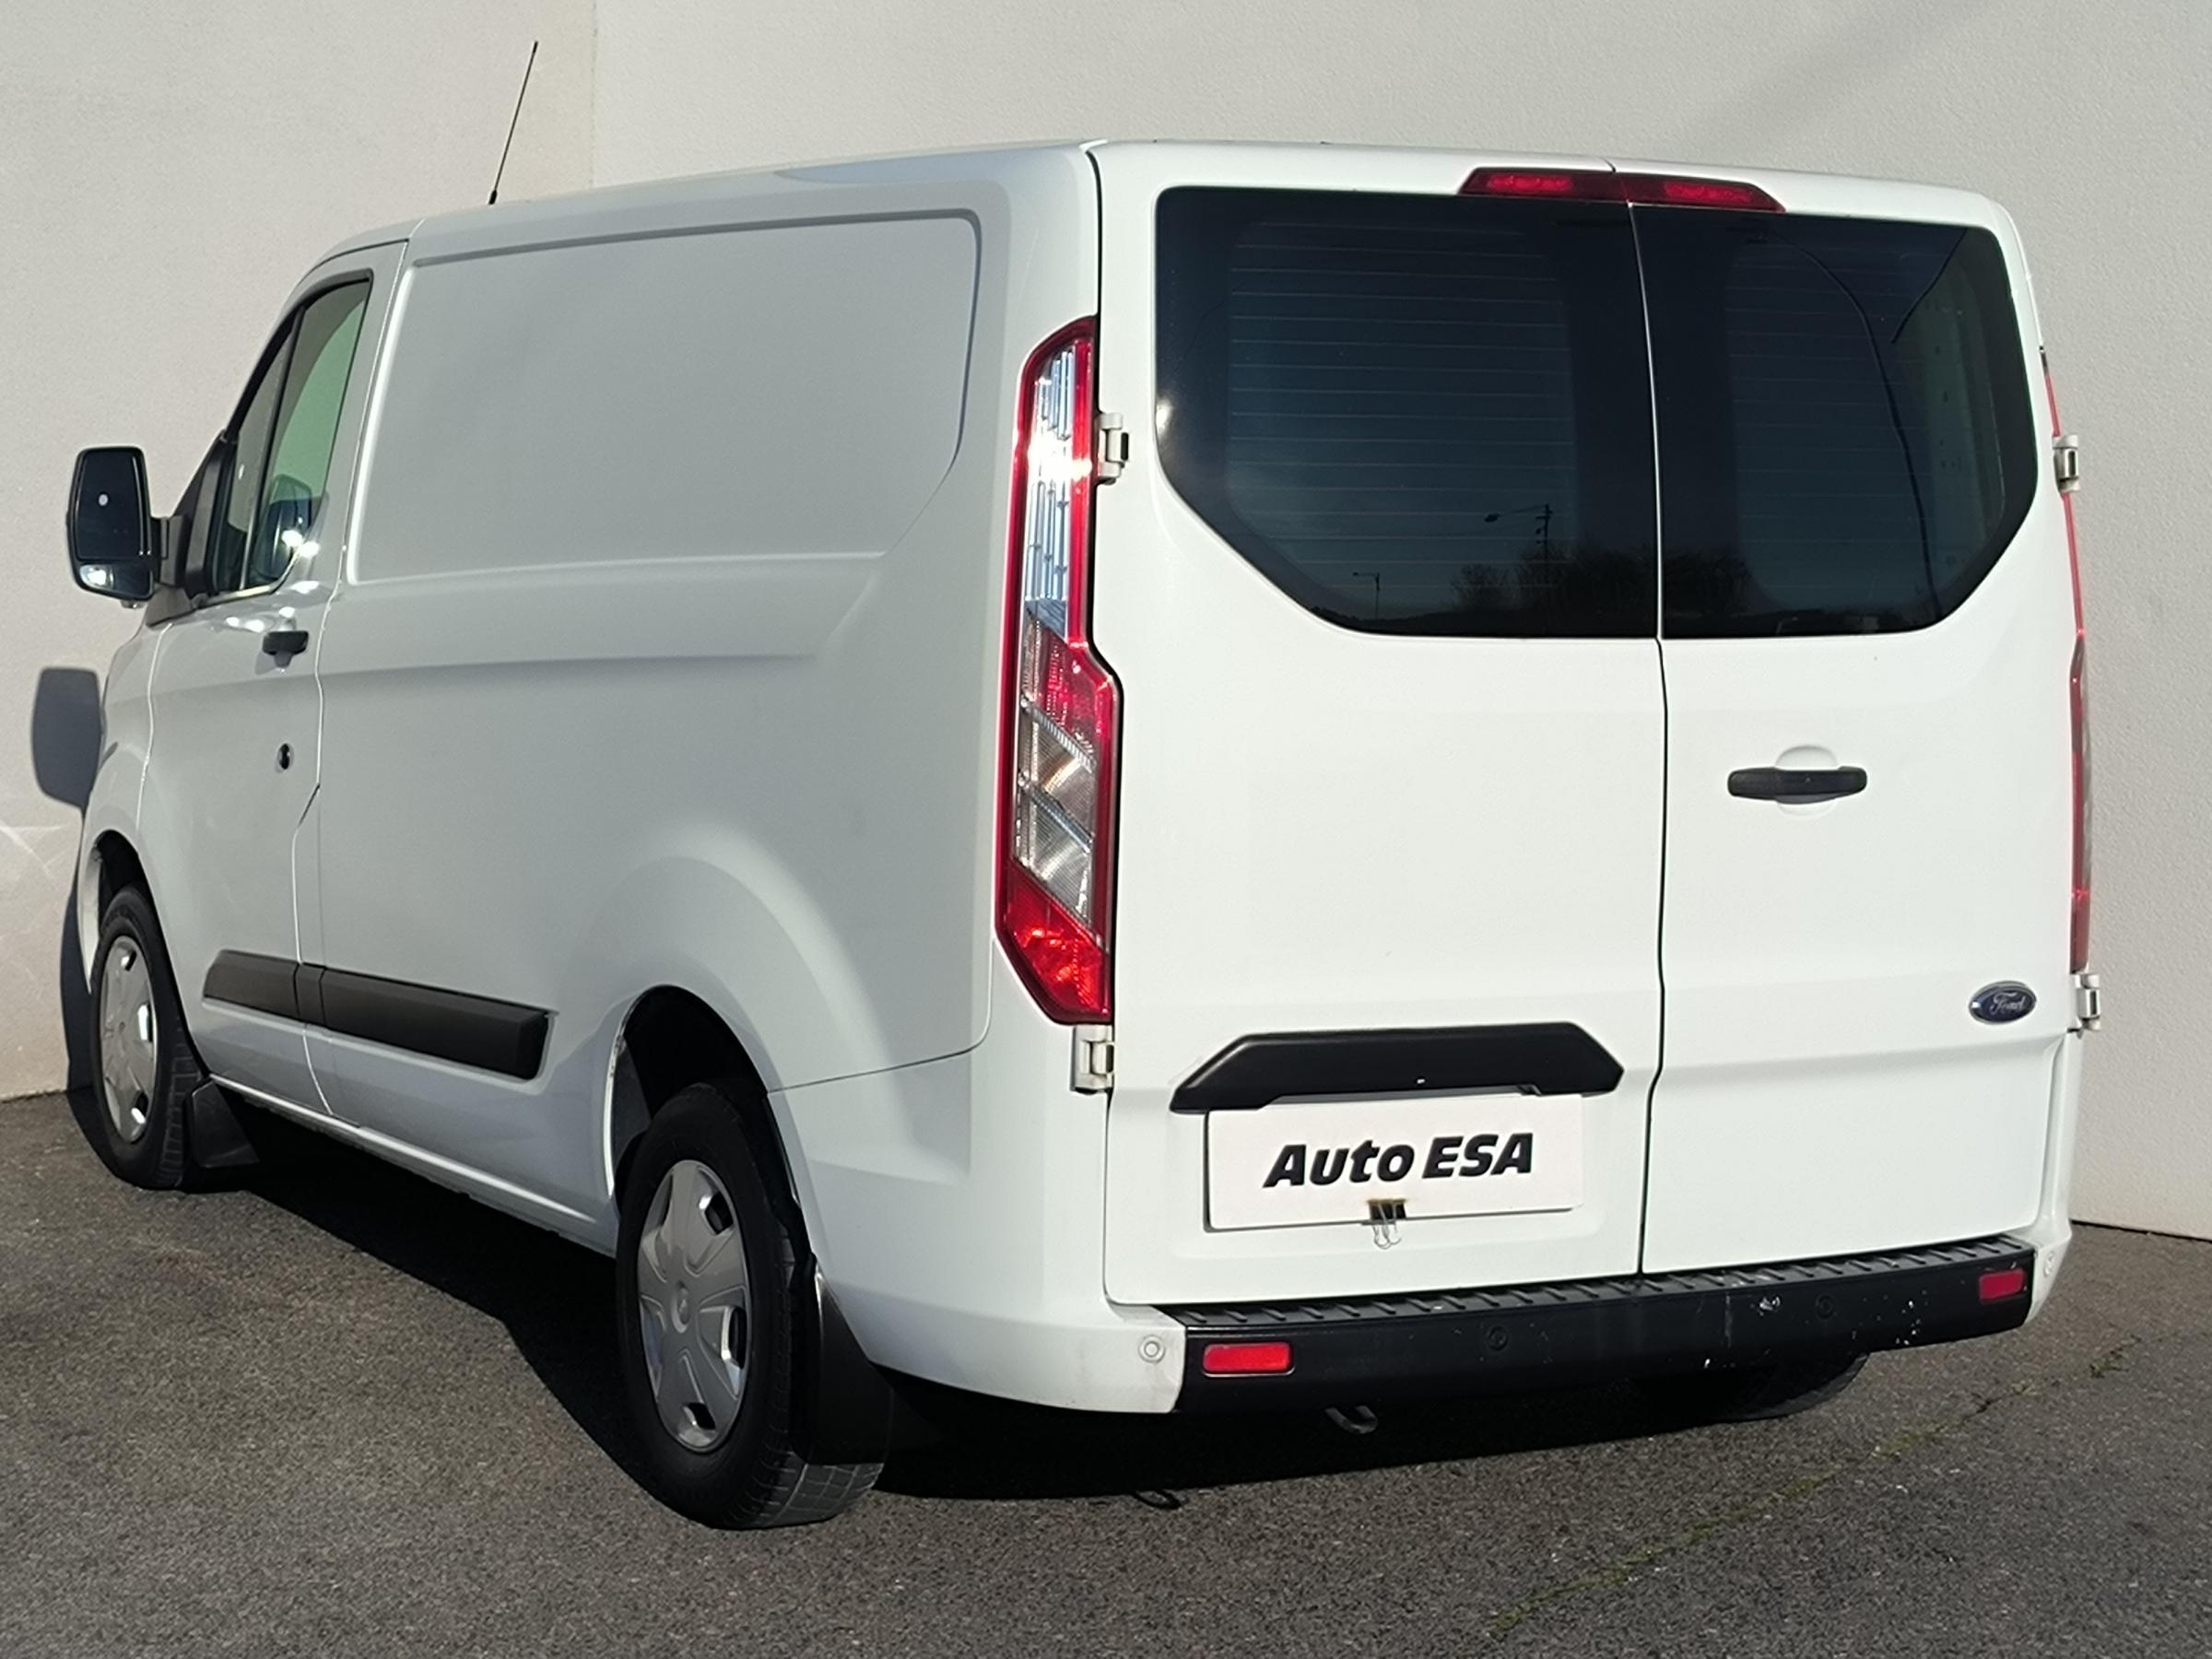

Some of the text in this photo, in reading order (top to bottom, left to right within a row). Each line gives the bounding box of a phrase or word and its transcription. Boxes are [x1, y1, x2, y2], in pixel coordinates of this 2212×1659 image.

[1989, 991, 2026, 1015] Ford
[1262, 1132, 1534, 1189] Auto ESA
